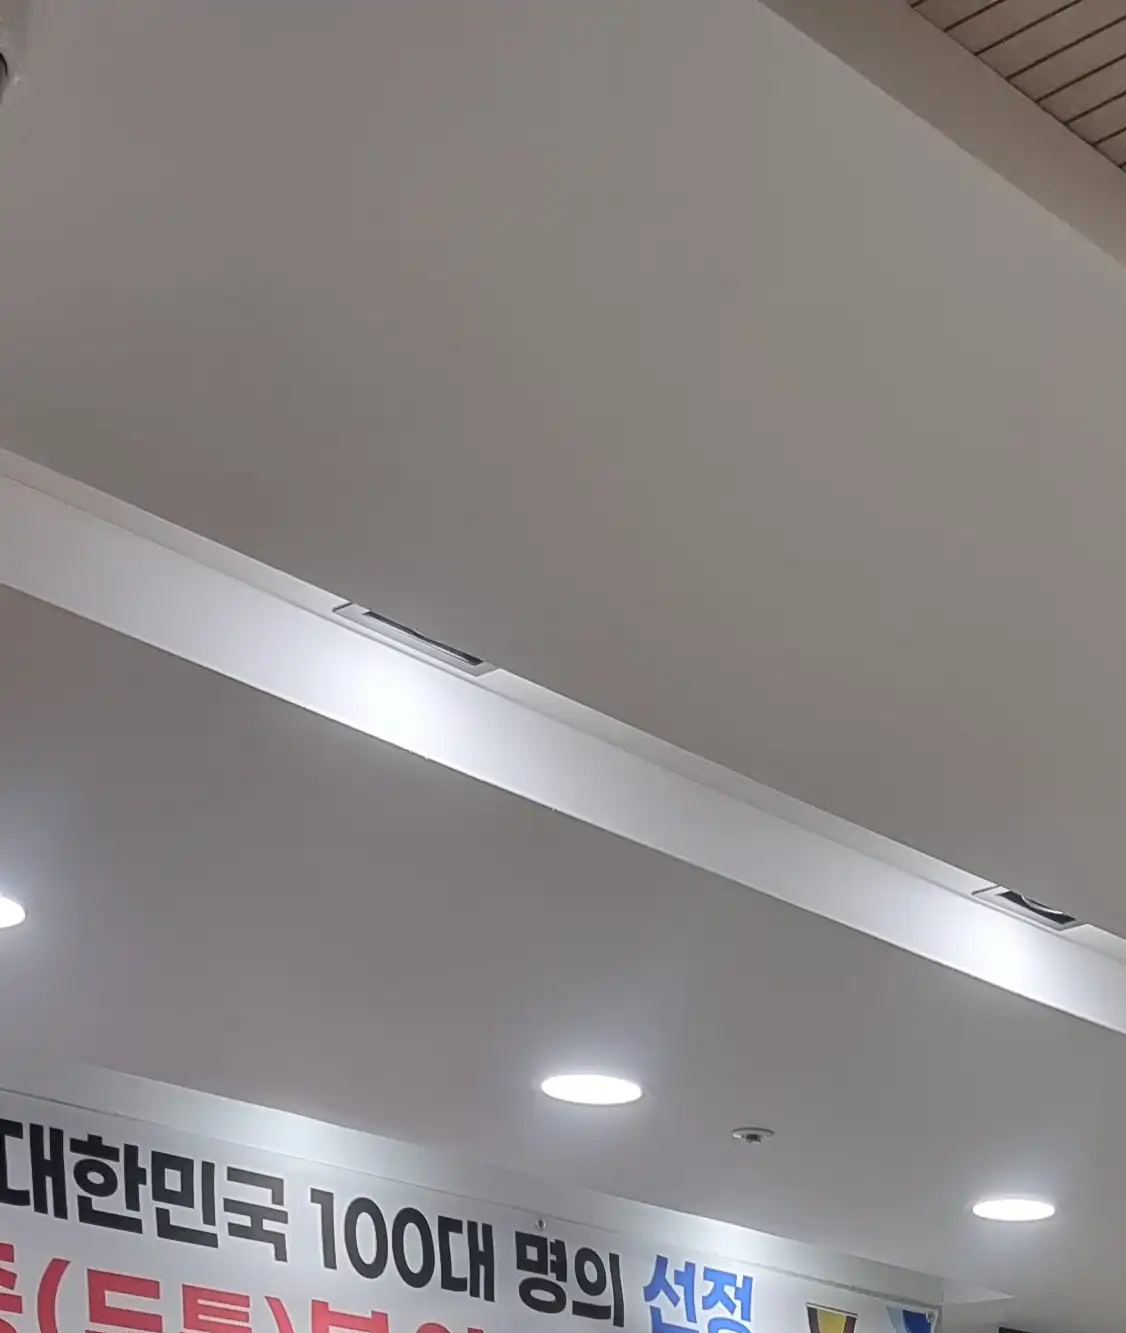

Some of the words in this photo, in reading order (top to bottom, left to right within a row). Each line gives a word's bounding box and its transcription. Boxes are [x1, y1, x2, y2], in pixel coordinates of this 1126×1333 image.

[0, 1119, 288, 1262] 대한민국
[310, 1187, 496, 1303] 100대
[514, 1230, 625, 1328] 명의
